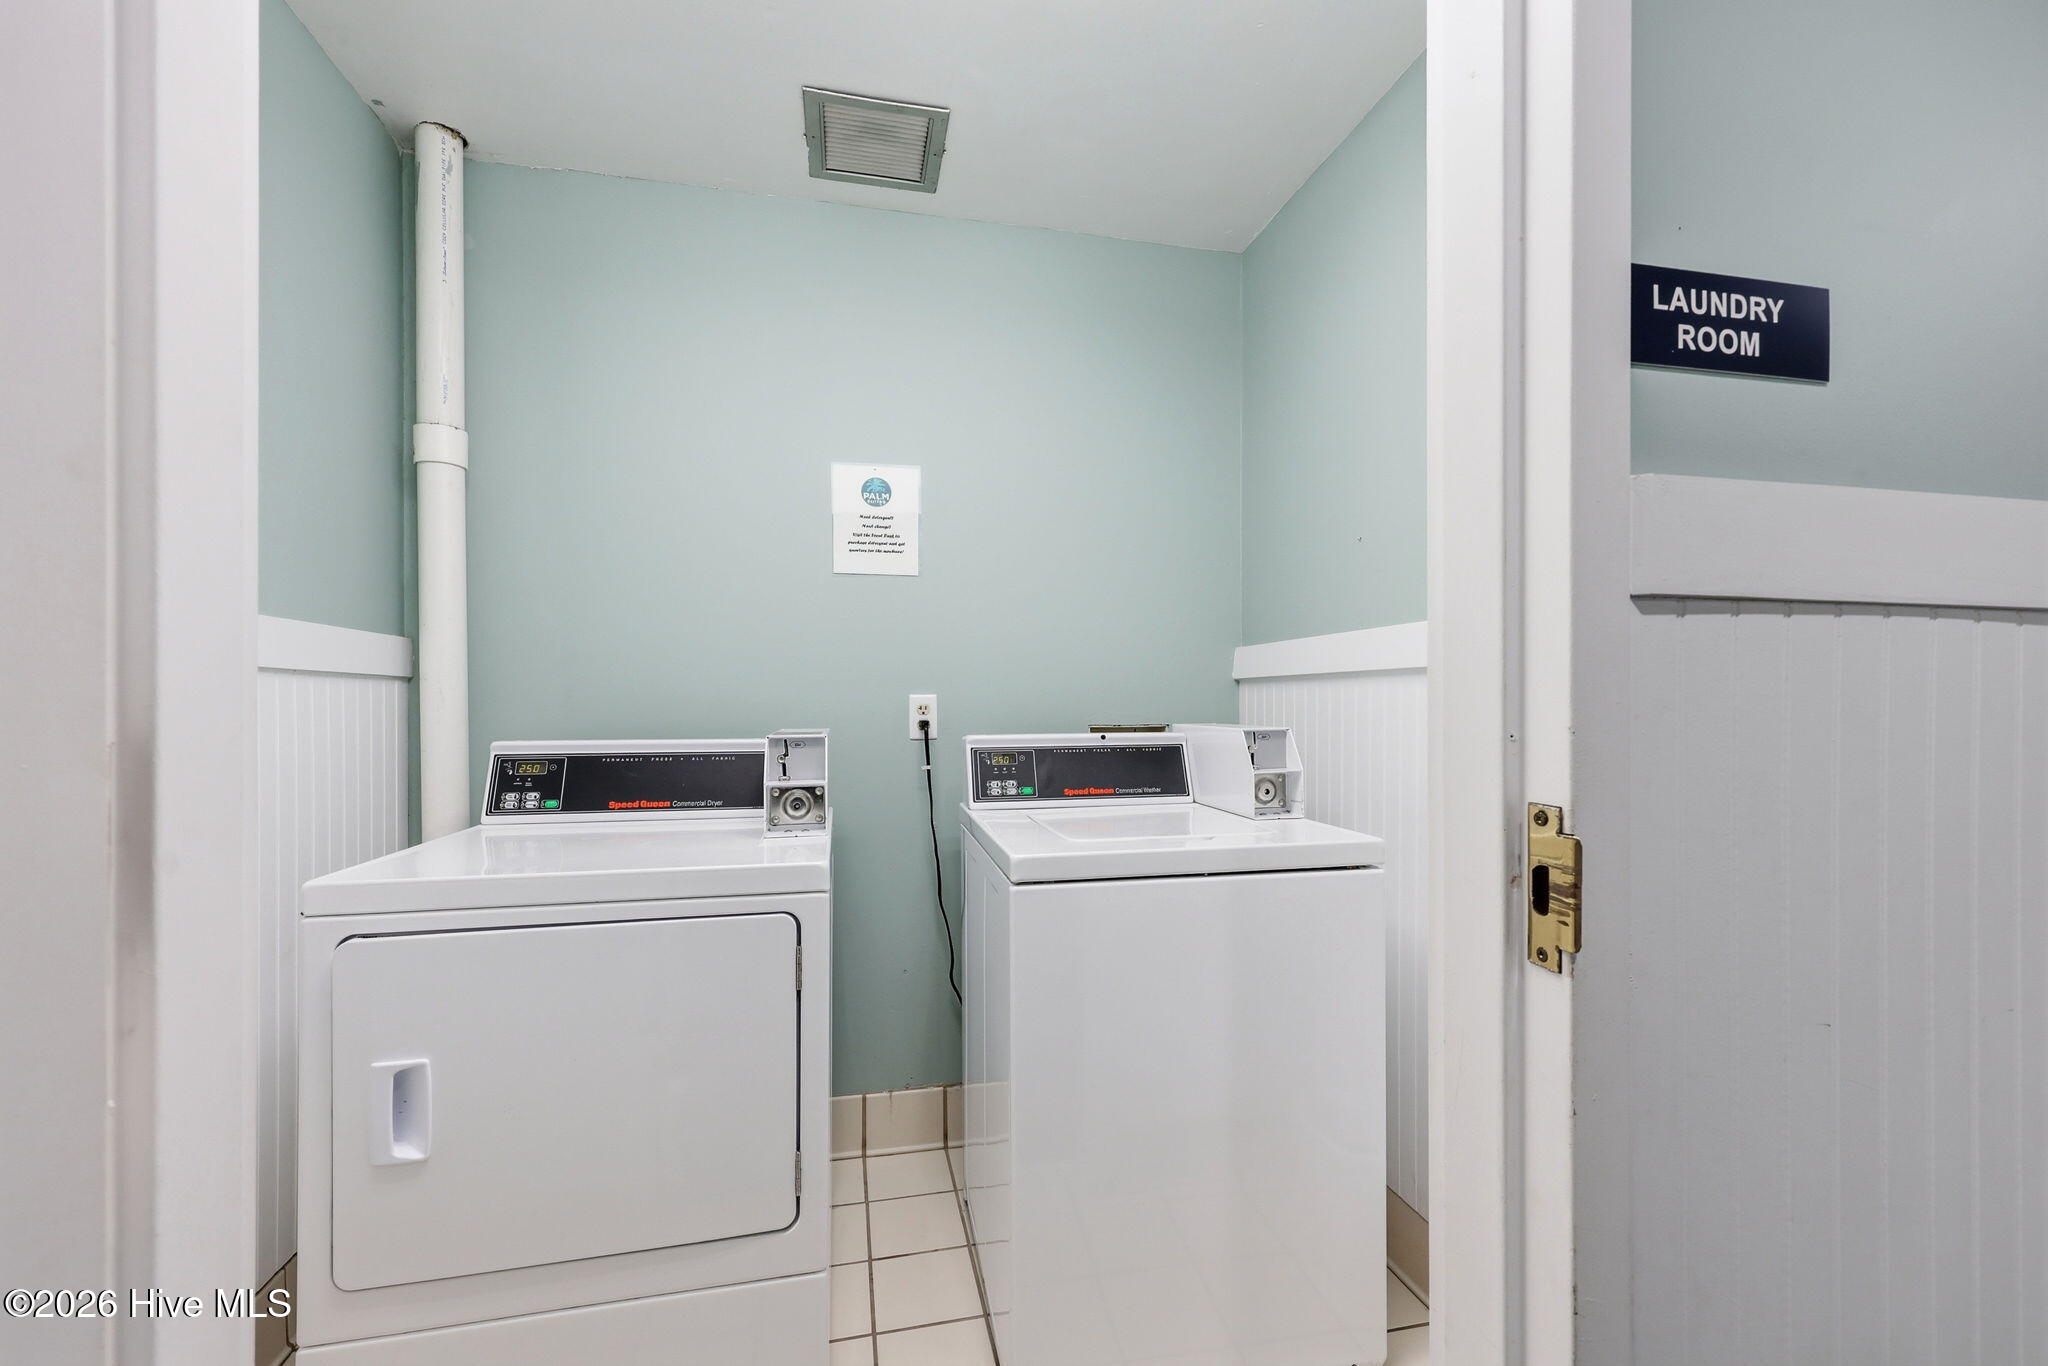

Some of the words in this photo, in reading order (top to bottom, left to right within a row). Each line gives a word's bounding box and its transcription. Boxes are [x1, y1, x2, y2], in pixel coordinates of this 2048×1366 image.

[1652, 283, 1785, 324] LAUNDRY
[1677, 323, 1761, 358] ROOM
[863, 492, 889, 500] PALM
[1063, 788, 1089, 797] Speed
[1089, 787, 1115, 795] Queen
[1115, 787, 1143, 795] Commercial
[608, 801, 639, 810] Speed
[640, 800, 671, 809] Queen
[672, 799, 707, 808] Commercial
[707, 799, 724, 809] Dryer
